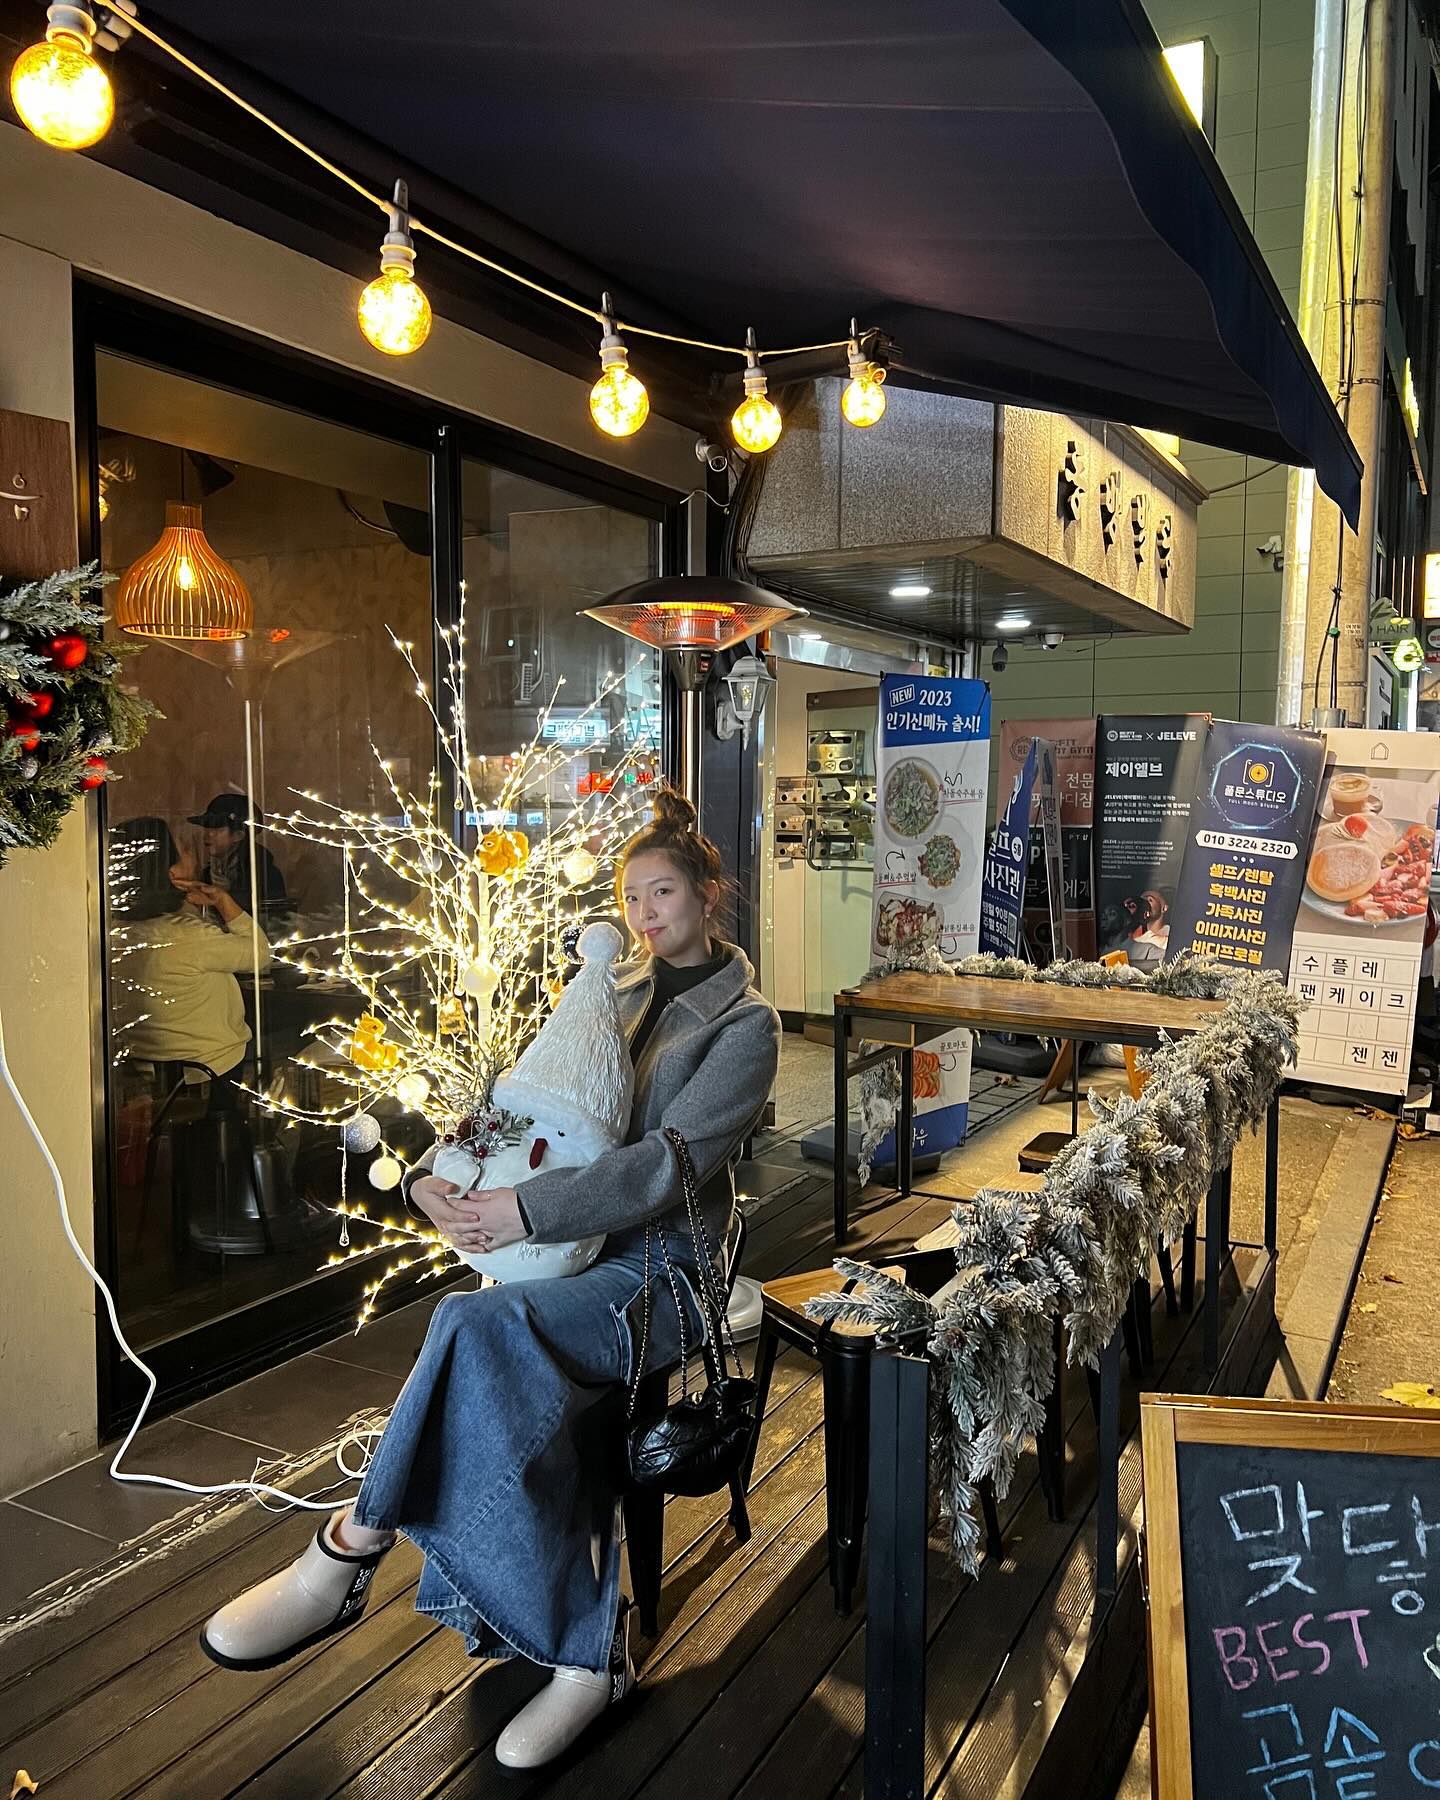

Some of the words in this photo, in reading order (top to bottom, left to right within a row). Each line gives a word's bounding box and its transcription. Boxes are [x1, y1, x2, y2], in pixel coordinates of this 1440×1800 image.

[1377, 624, 1409, 635] HAIR
[891, 686, 914, 705] NEW
[919, 689, 952, 707] 2023
[886, 711, 948, 732] 인기신메뉴
[952, 714, 981, 734] 출시!
[1157, 731, 1197, 741] JELEVE
[1066, 772, 1094, 789] 전문
[1105, 761, 1163, 778] 제이엘브
[1224, 784, 1287, 804] 풀문스튜디오
[1203, 833, 1225, 846] 010
[1228, 837, 1257, 850] 3224
[1260, 842, 1291, 855] 2320
[984, 859, 1020, 900] 사진관
[1209, 863, 1274, 887] 셀프/렌탈
[1209, 883, 1267, 905] 흑백사진
[1205, 902, 1263, 925] 가족사진
[1195, 920, 1267, 946] 이미지사진
[1191, 939, 1263, 966] 바디프로필
[1302, 955, 1378, 978] 수플레
[1299, 982, 1405, 1010] 팬케이크
[1351, 1046, 1399, 1069] 젠젠
[353, 1568, 371, 1593] UGG
[612, 1634, 623, 1664] UGG
[1212, 1608, 1371, 1691] BEST
